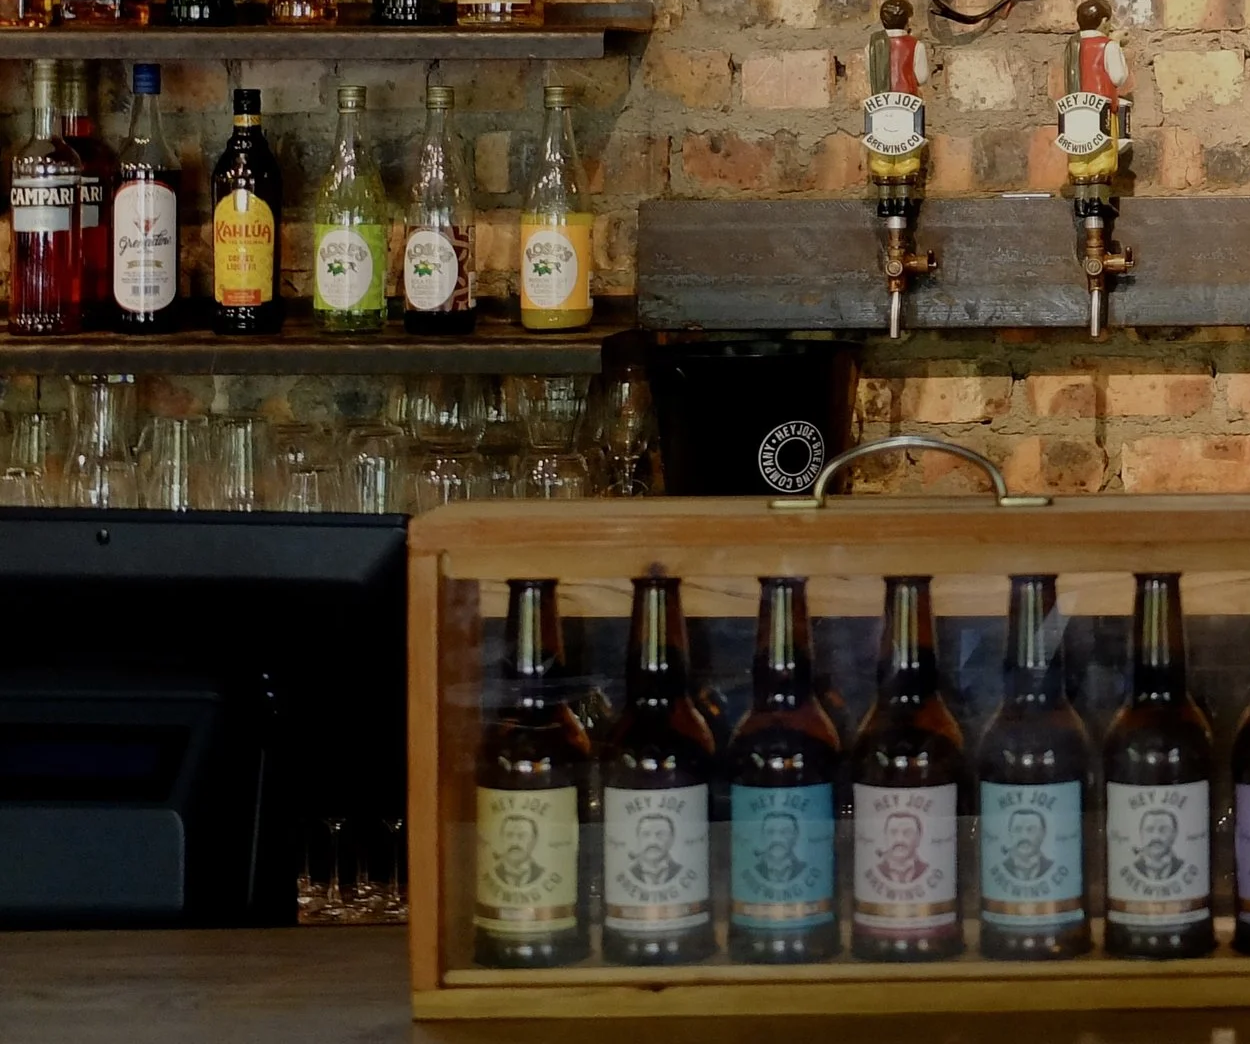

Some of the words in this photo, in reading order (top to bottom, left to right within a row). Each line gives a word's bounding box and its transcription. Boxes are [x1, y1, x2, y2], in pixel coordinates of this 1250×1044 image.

[865, 94, 890, 112] HEY
[894, 94, 920, 111] JOE
[1058, 94, 1078, 112] HEY
[1082, 94, 1103, 110] JOE
[866, 135, 908, 153] BREWING
[907, 134, 920, 146] CO
[1058, 136, 1092, 153] BREWING
[1093, 133, 1103, 146] CO
[10, 187, 74, 206] CAMPARI
[775, 424, 796, 441] HEY
[797, 424, 815, 440] JOE
[762, 443, 793, 489] COMPANY
[795, 441, 822, 487] BREWING
[490, 796, 515, 814] HEY
[523, 796, 550, 815] JOE
[624, 796, 651, 815] HEY
[659, 796, 686, 816] JOE
[751, 794, 775, 812] HEY
[783, 794, 810, 812] JOE
[873, 794, 901, 813] HEY
[909, 794, 935, 813] JOE
[997, 792, 1023, 809] HEY
[1029, 792, 1057, 811] JOE
[1127, 791, 1156, 809] HEY
[1160, 790, 1188, 809] JOE
